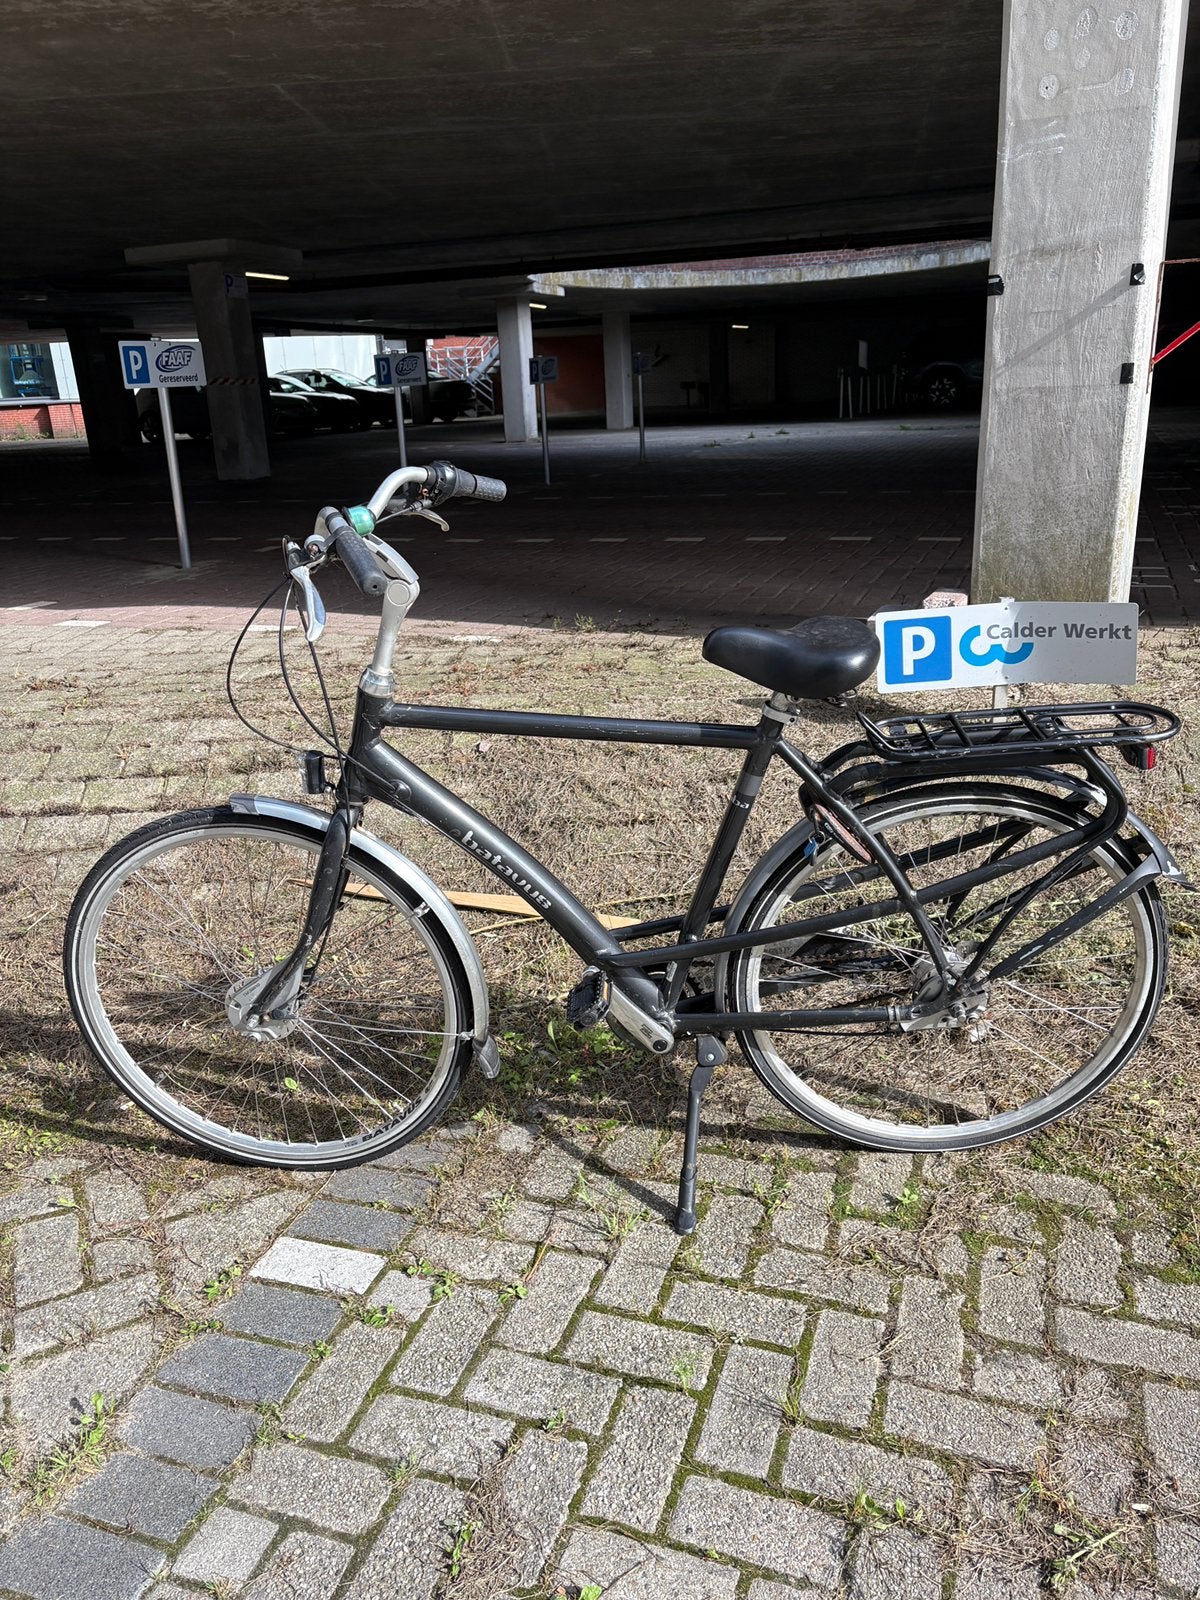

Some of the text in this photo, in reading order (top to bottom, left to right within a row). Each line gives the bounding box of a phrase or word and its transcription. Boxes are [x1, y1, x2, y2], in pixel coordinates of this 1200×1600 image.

[129, 350, 143, 380] P
[160, 350, 193, 367] FAAF
[380, 360, 388, 382] P
[158, 373, 199, 383] Gereserveerd
[986, 621, 1132, 640] Calder Werkt
[901, 625, 937, 676] P
[461, 830, 552, 909] batavus
[362, 1096, 422, 1142] BATAVUS
